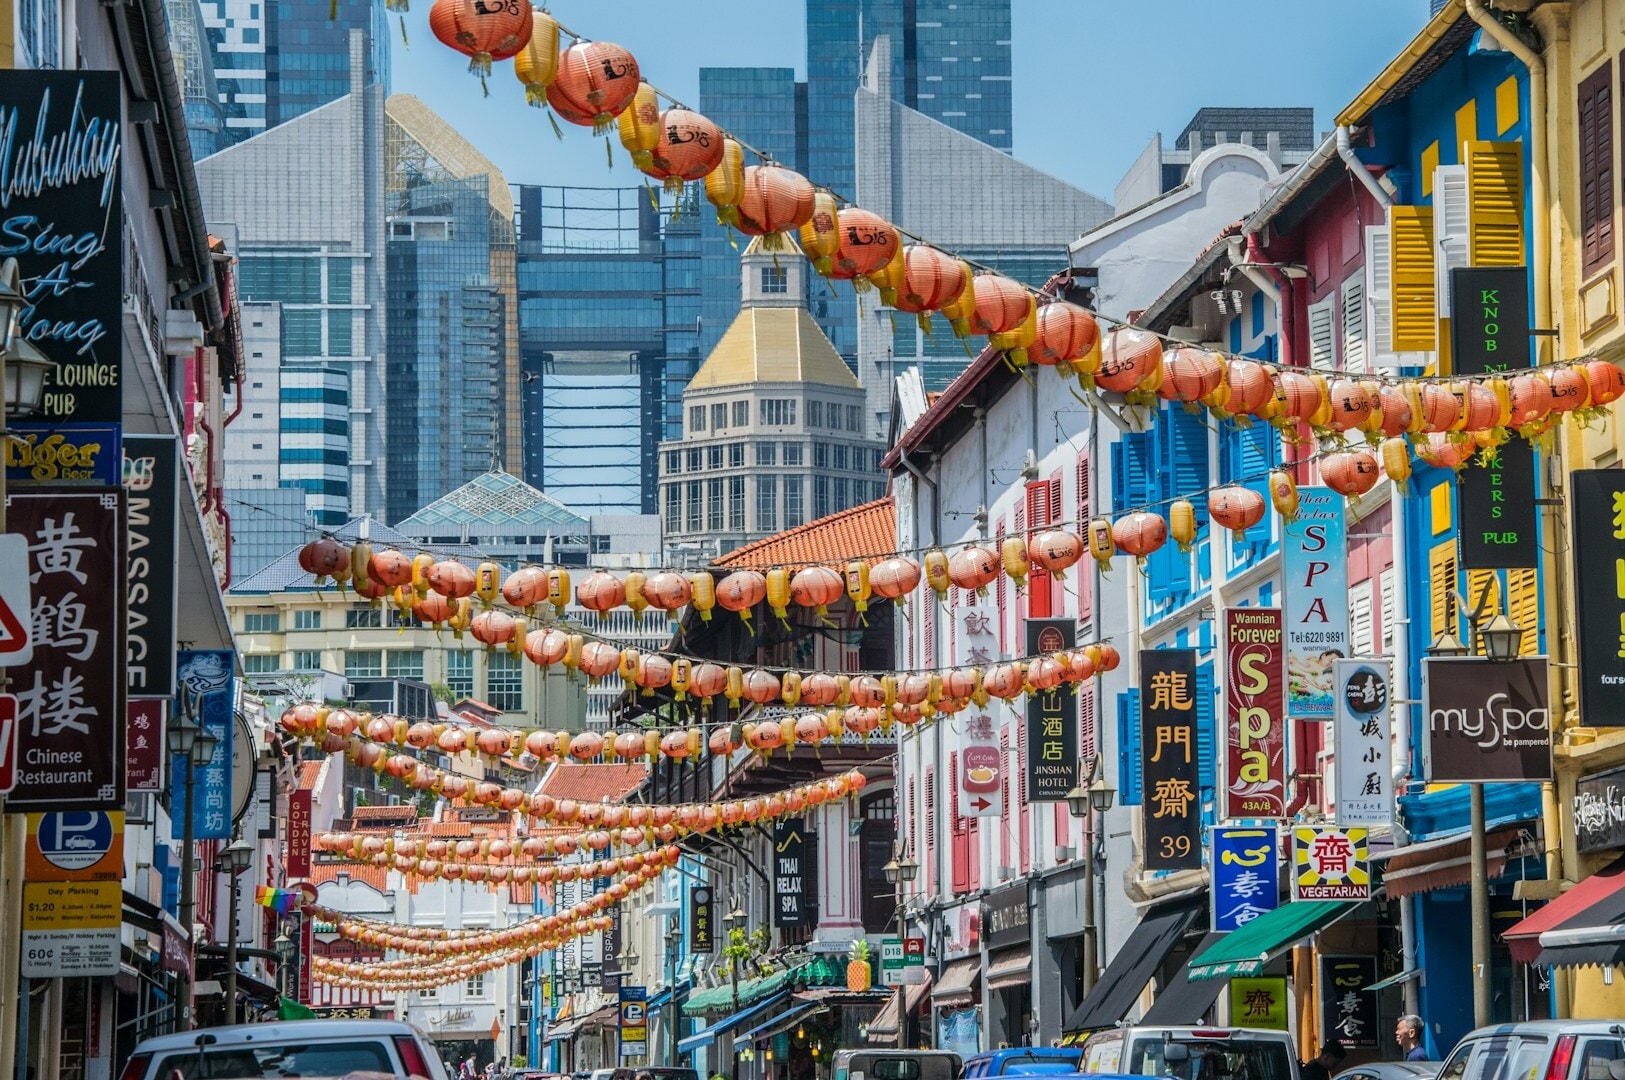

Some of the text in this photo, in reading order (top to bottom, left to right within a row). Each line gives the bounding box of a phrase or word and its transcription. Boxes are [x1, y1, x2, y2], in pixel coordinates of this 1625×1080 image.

[0, 215, 105, 270] Sing
[1481, 290, 1500, 352] KNOB
[56, 364, 118, 386] LOUNGE
[44, 393, 75, 416] PUB
[61, 467, 94, 480] Beer
[1297, 491, 1331, 505] Thai
[1294, 508, 1337, 520] Relax
[1482, 532, 1518, 544] PUB
[1301, 524, 1330, 623] SPA
[127, 497, 150, 688] MASSAGE
[1235, 613, 1275, 624] Wannian
[1230, 625, 1281, 643] Forever
[1325, 631, 1345, 643] 9891
[1239, 652, 1271, 783] Spa
[1503, 738, 1549, 747] be pampered
[26, 749, 83, 764] Chinese
[16, 769, 93, 785] Restaurant
[1034, 766, 1072, 775] JINSHAN
[1038, 778, 1068, 787] HOTEL
[292, 802, 300, 857] GOLDEN
[301, 811, 309, 866] TRAVEL
[1159, 835, 1191, 858] 39
[779, 858, 798, 874] THAI
[48, 887, 99, 896] Day Parking
[776, 877, 802, 893] RELAX
[1300, 886, 1367, 897] VEGETARIAN
[28, 903, 54, 912] $1.20
[782, 896, 798, 913] SPA
[885, 948, 901, 956] D18
[886, 972, 891, 982] 1
[1477, 964, 1484, 978] 7
[183, 1006, 190, 1019] 8
